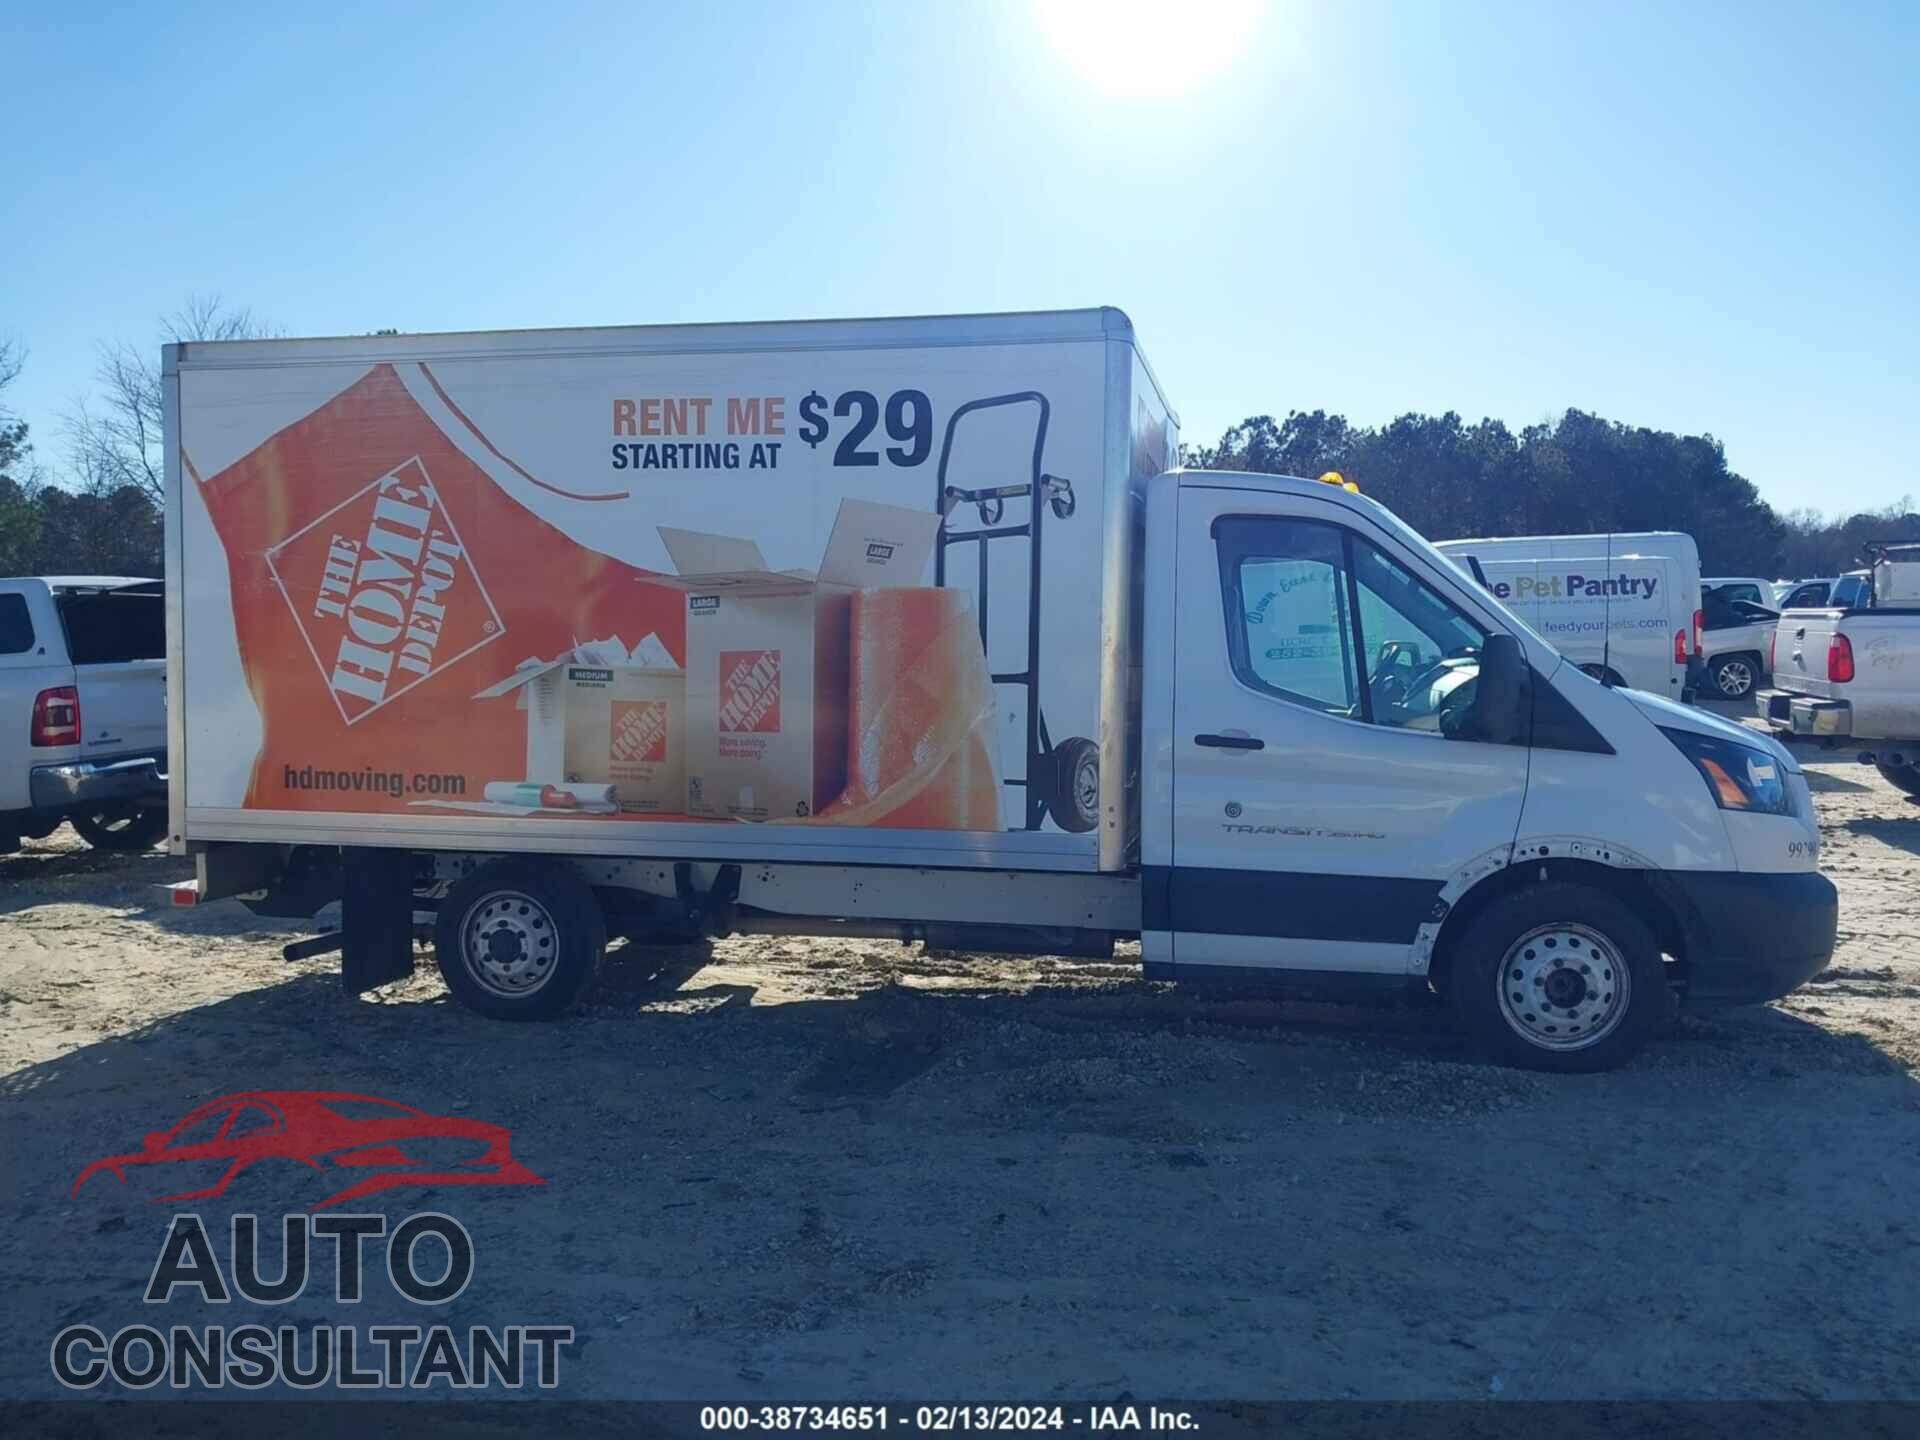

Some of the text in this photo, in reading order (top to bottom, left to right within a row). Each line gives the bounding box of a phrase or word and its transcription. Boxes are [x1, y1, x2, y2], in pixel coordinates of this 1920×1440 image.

[612, 397, 785, 436] RENT ME
[799, 389, 933, 468] $29
[612, 443, 782, 469] STARTING AT
[314, 533, 362, 619] THE
[331, 475, 435, 705] HOME
[1516, 576, 1562, 598] Pet
[1566, 573, 1658, 600] Pantry
[397, 532, 463, 675] DEPOT
[575, 671, 608, 680] MEDIUM
[719, 649, 783, 732] HOME
[611, 699, 665, 761] HOME
[284, 765, 466, 797] hdmoving.com
[1221, 823, 1325, 837] TRANSIT
